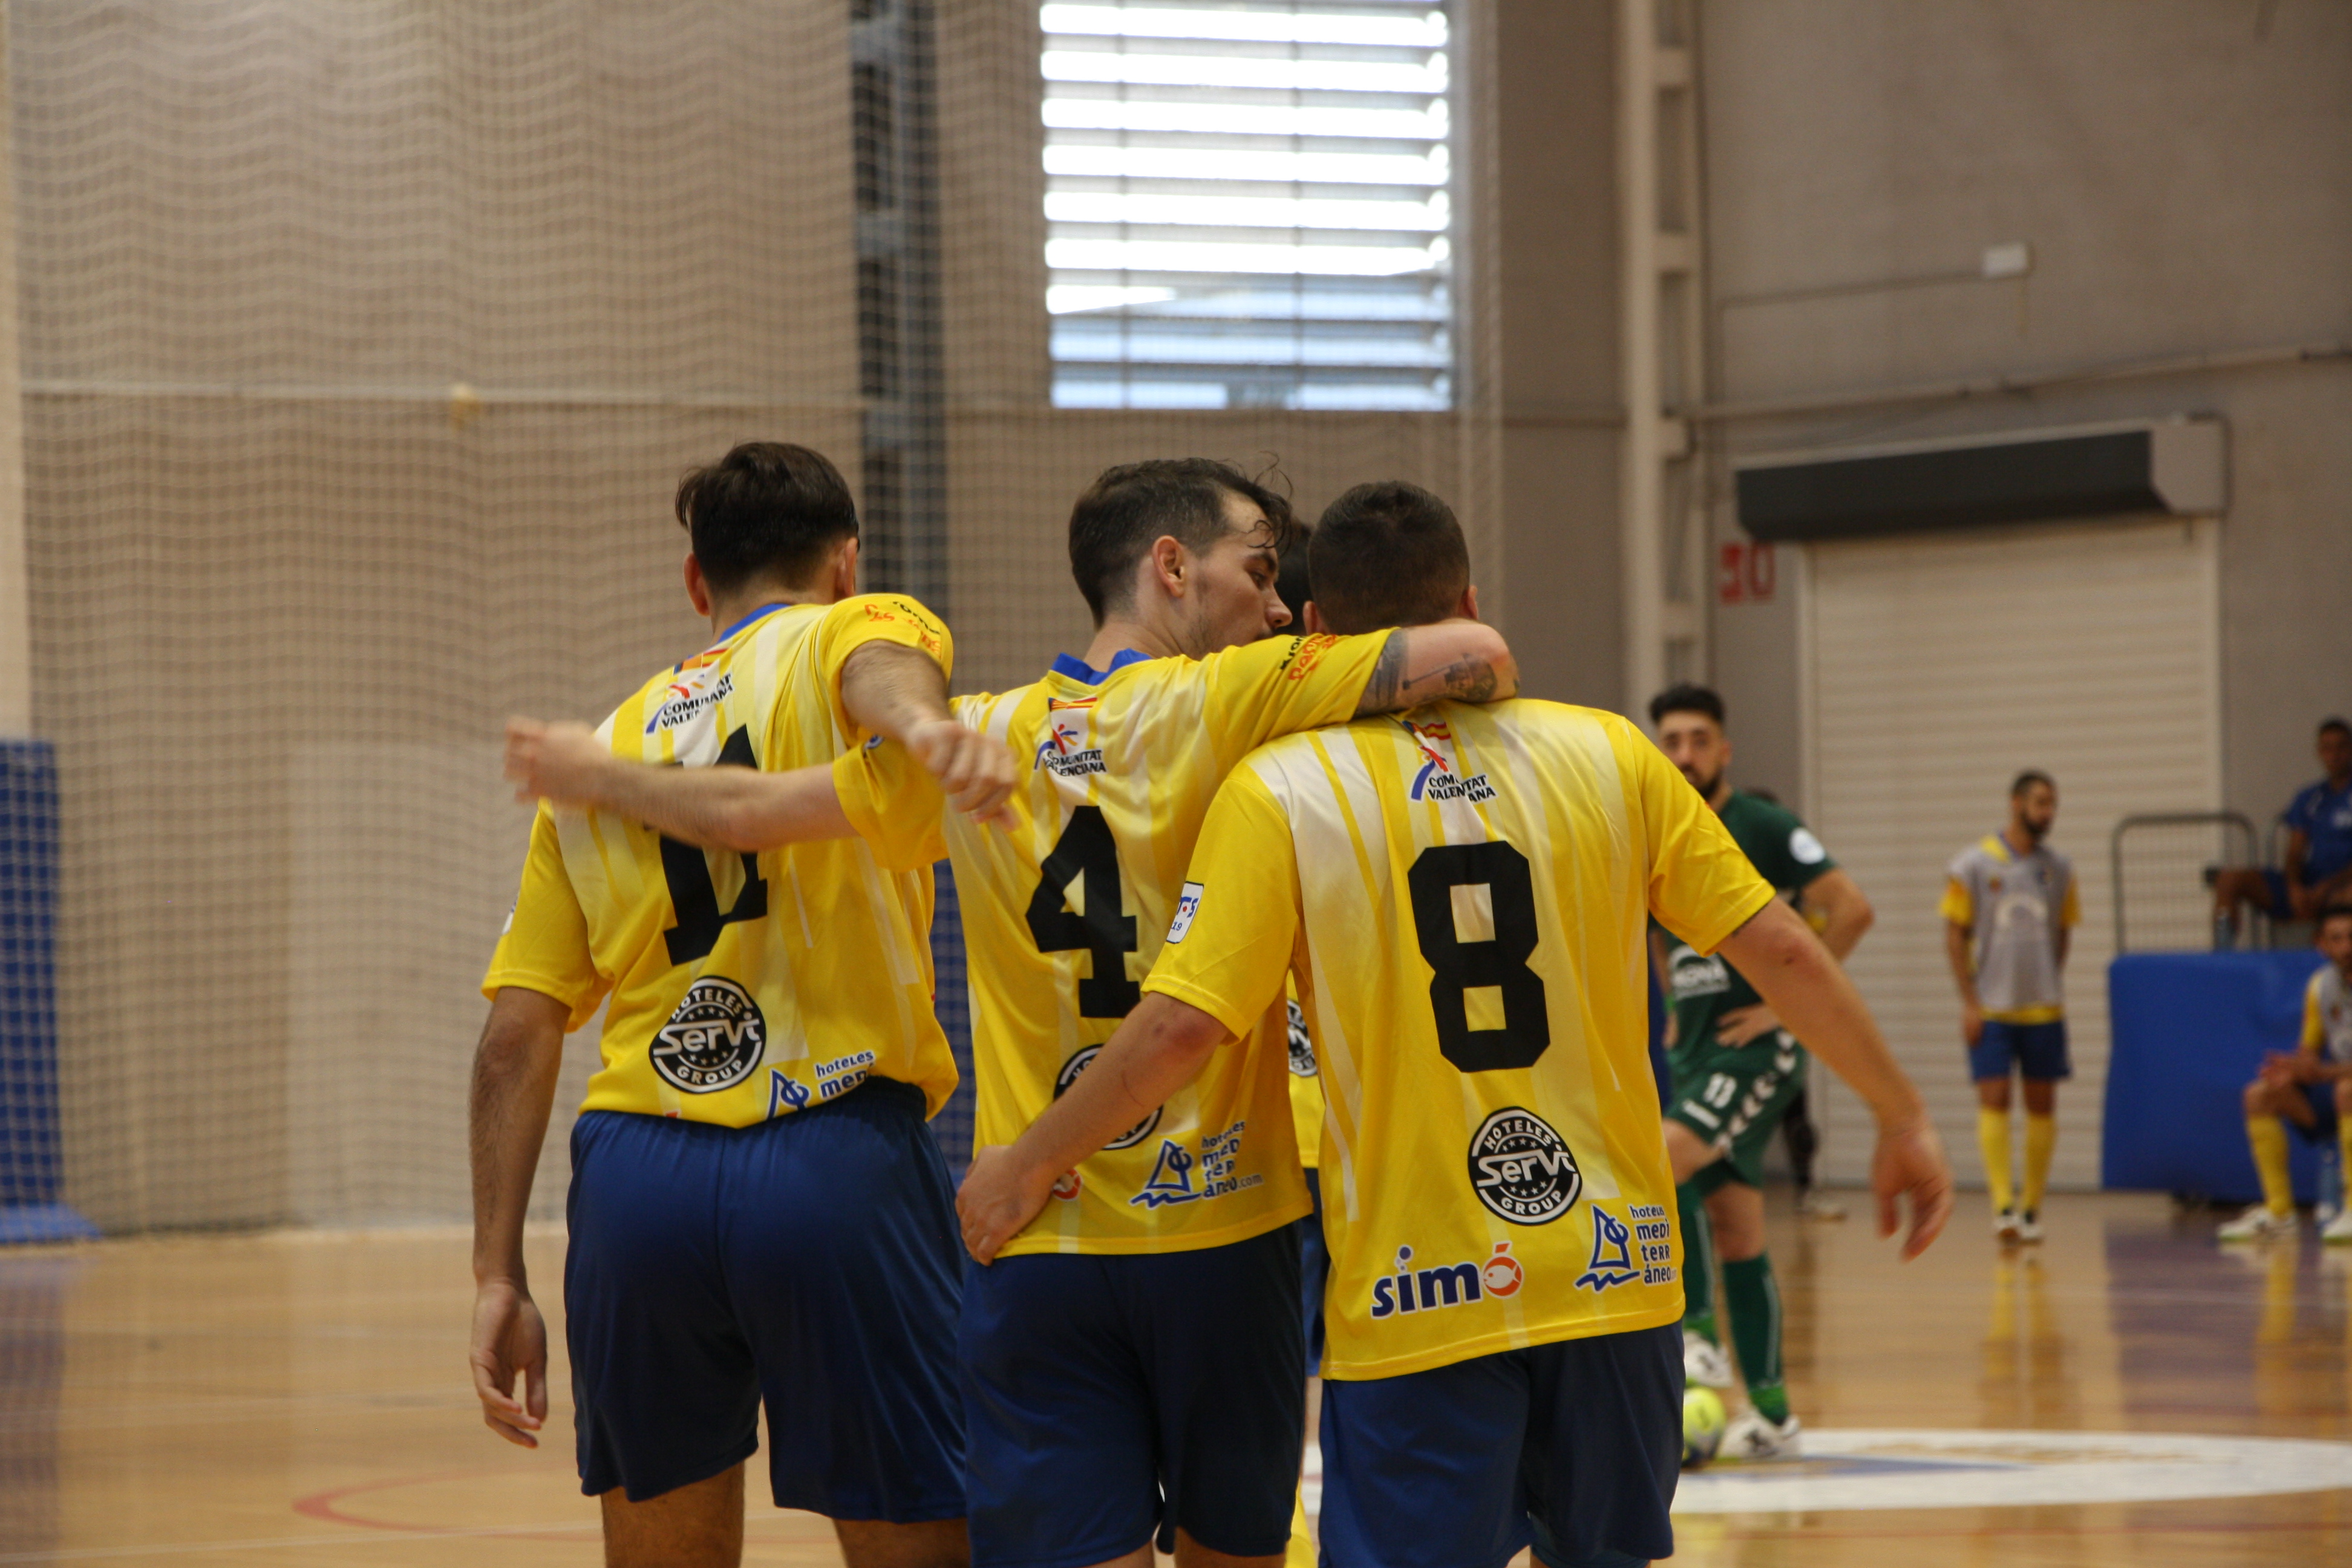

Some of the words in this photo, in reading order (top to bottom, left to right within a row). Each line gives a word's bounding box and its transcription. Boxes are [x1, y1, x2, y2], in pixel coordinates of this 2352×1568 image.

[664, 673, 731, 716] COMUAT
[1428, 774, 1486, 791] COMTAT
[1428, 786, 1497, 803] VALENANA
[1025, 805, 1142, 1018] 4
[1407, 840, 1550, 1073] 8
[676, 1059, 743, 1085] GROUP
[1484, 1120, 1553, 1150] HOTELES
[1501, 1190, 1562, 1215] GROUP
